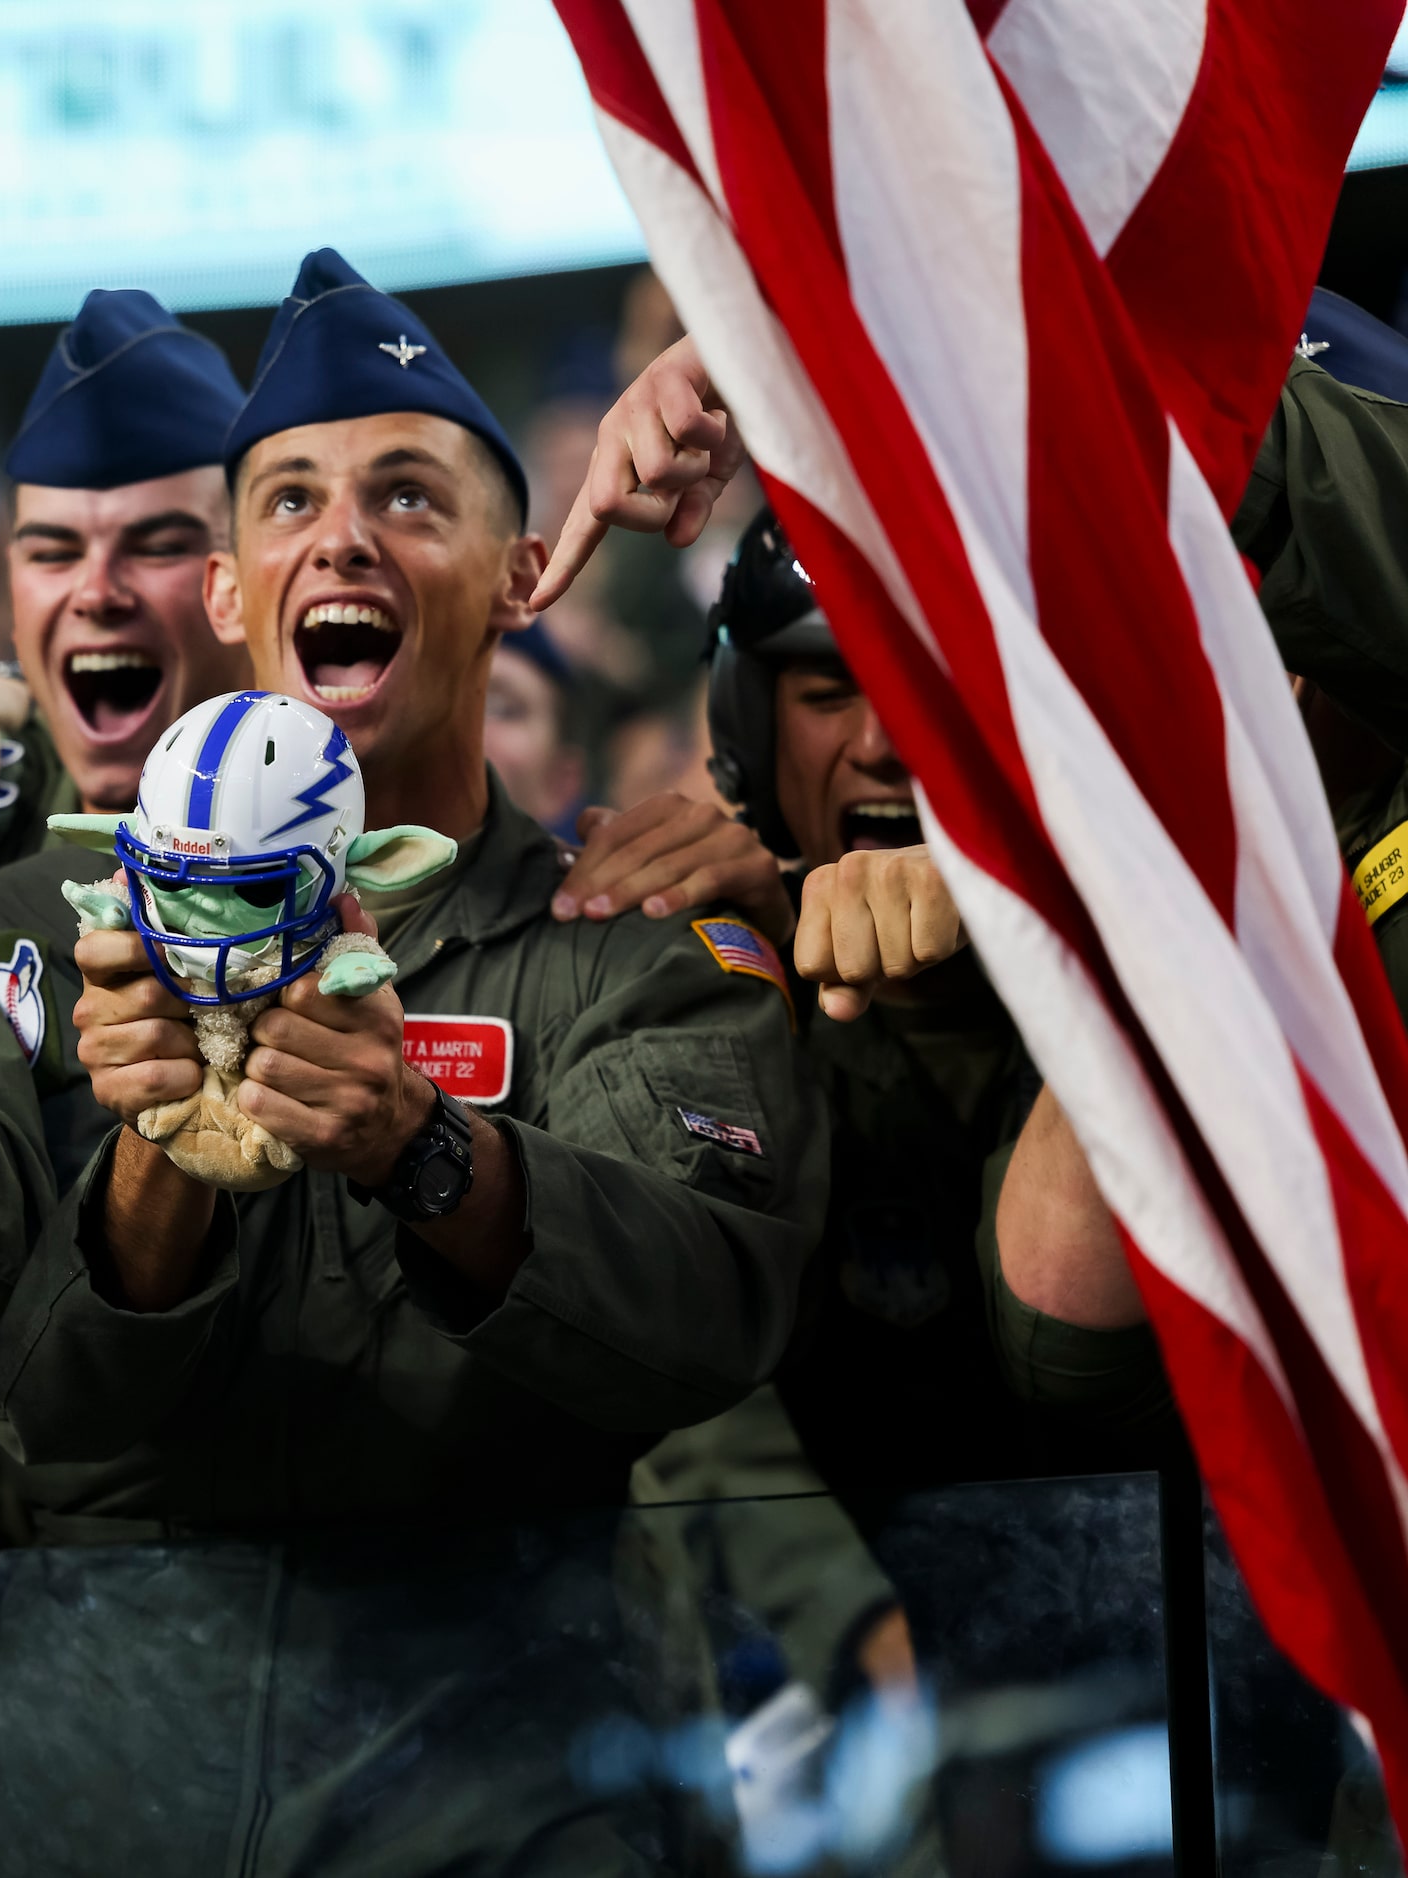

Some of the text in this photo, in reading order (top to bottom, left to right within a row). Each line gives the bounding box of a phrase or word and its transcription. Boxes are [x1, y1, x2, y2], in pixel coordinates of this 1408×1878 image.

[1388, 866, 1405, 885] 23
[417, 1041, 427, 1056] A
[432, 1041, 483, 1058] MARTIN
[455, 1062, 476, 1078] 22
